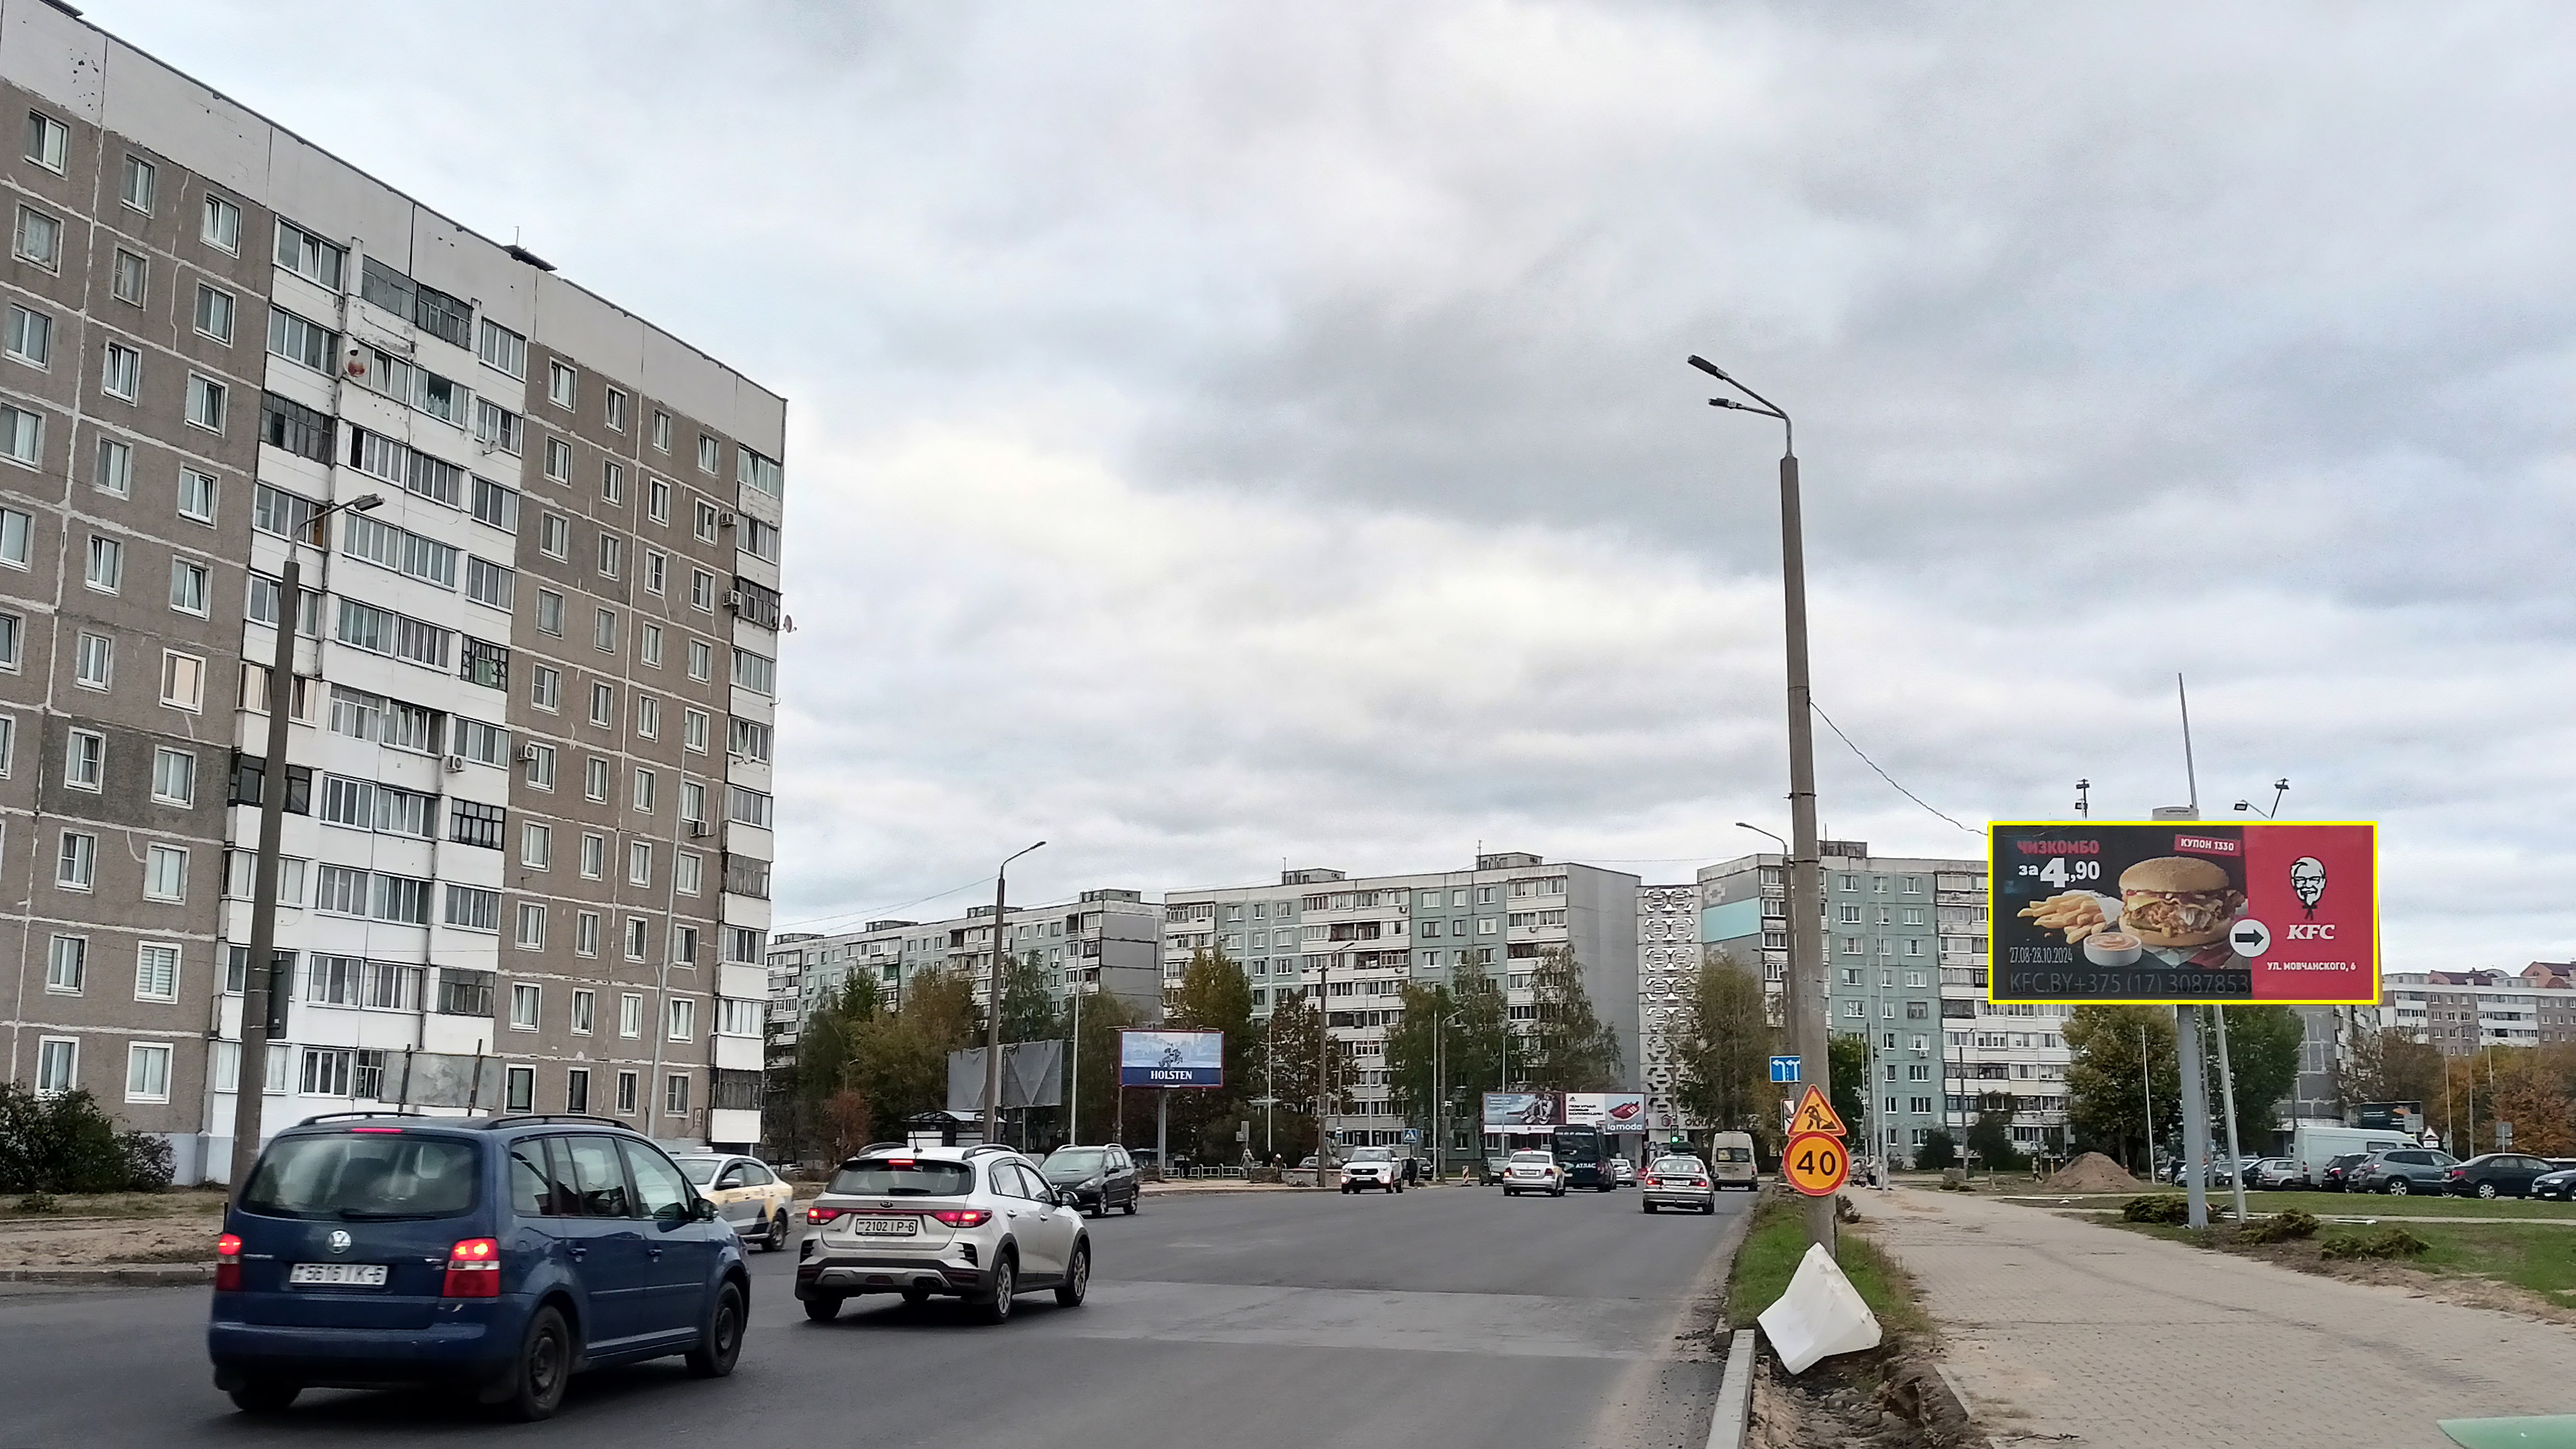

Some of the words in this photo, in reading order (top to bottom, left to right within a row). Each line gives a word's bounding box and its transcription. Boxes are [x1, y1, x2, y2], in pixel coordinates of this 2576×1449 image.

[2016, 840, 2100, 854] ЧИЗКОМБО
[2180, 838, 2212, 849] КУПОН
[2214, 841, 2234, 851] 1330
[2018, 865, 2039, 876] за
[2287, 924, 2336, 940] KFC
[2350, 962, 2356, 971] 6
[1150, 1070, 1193, 1080] HOLSTEN
[1796, 1150, 1837, 1177] 40
[865, 1221, 888, 1232] 2102
